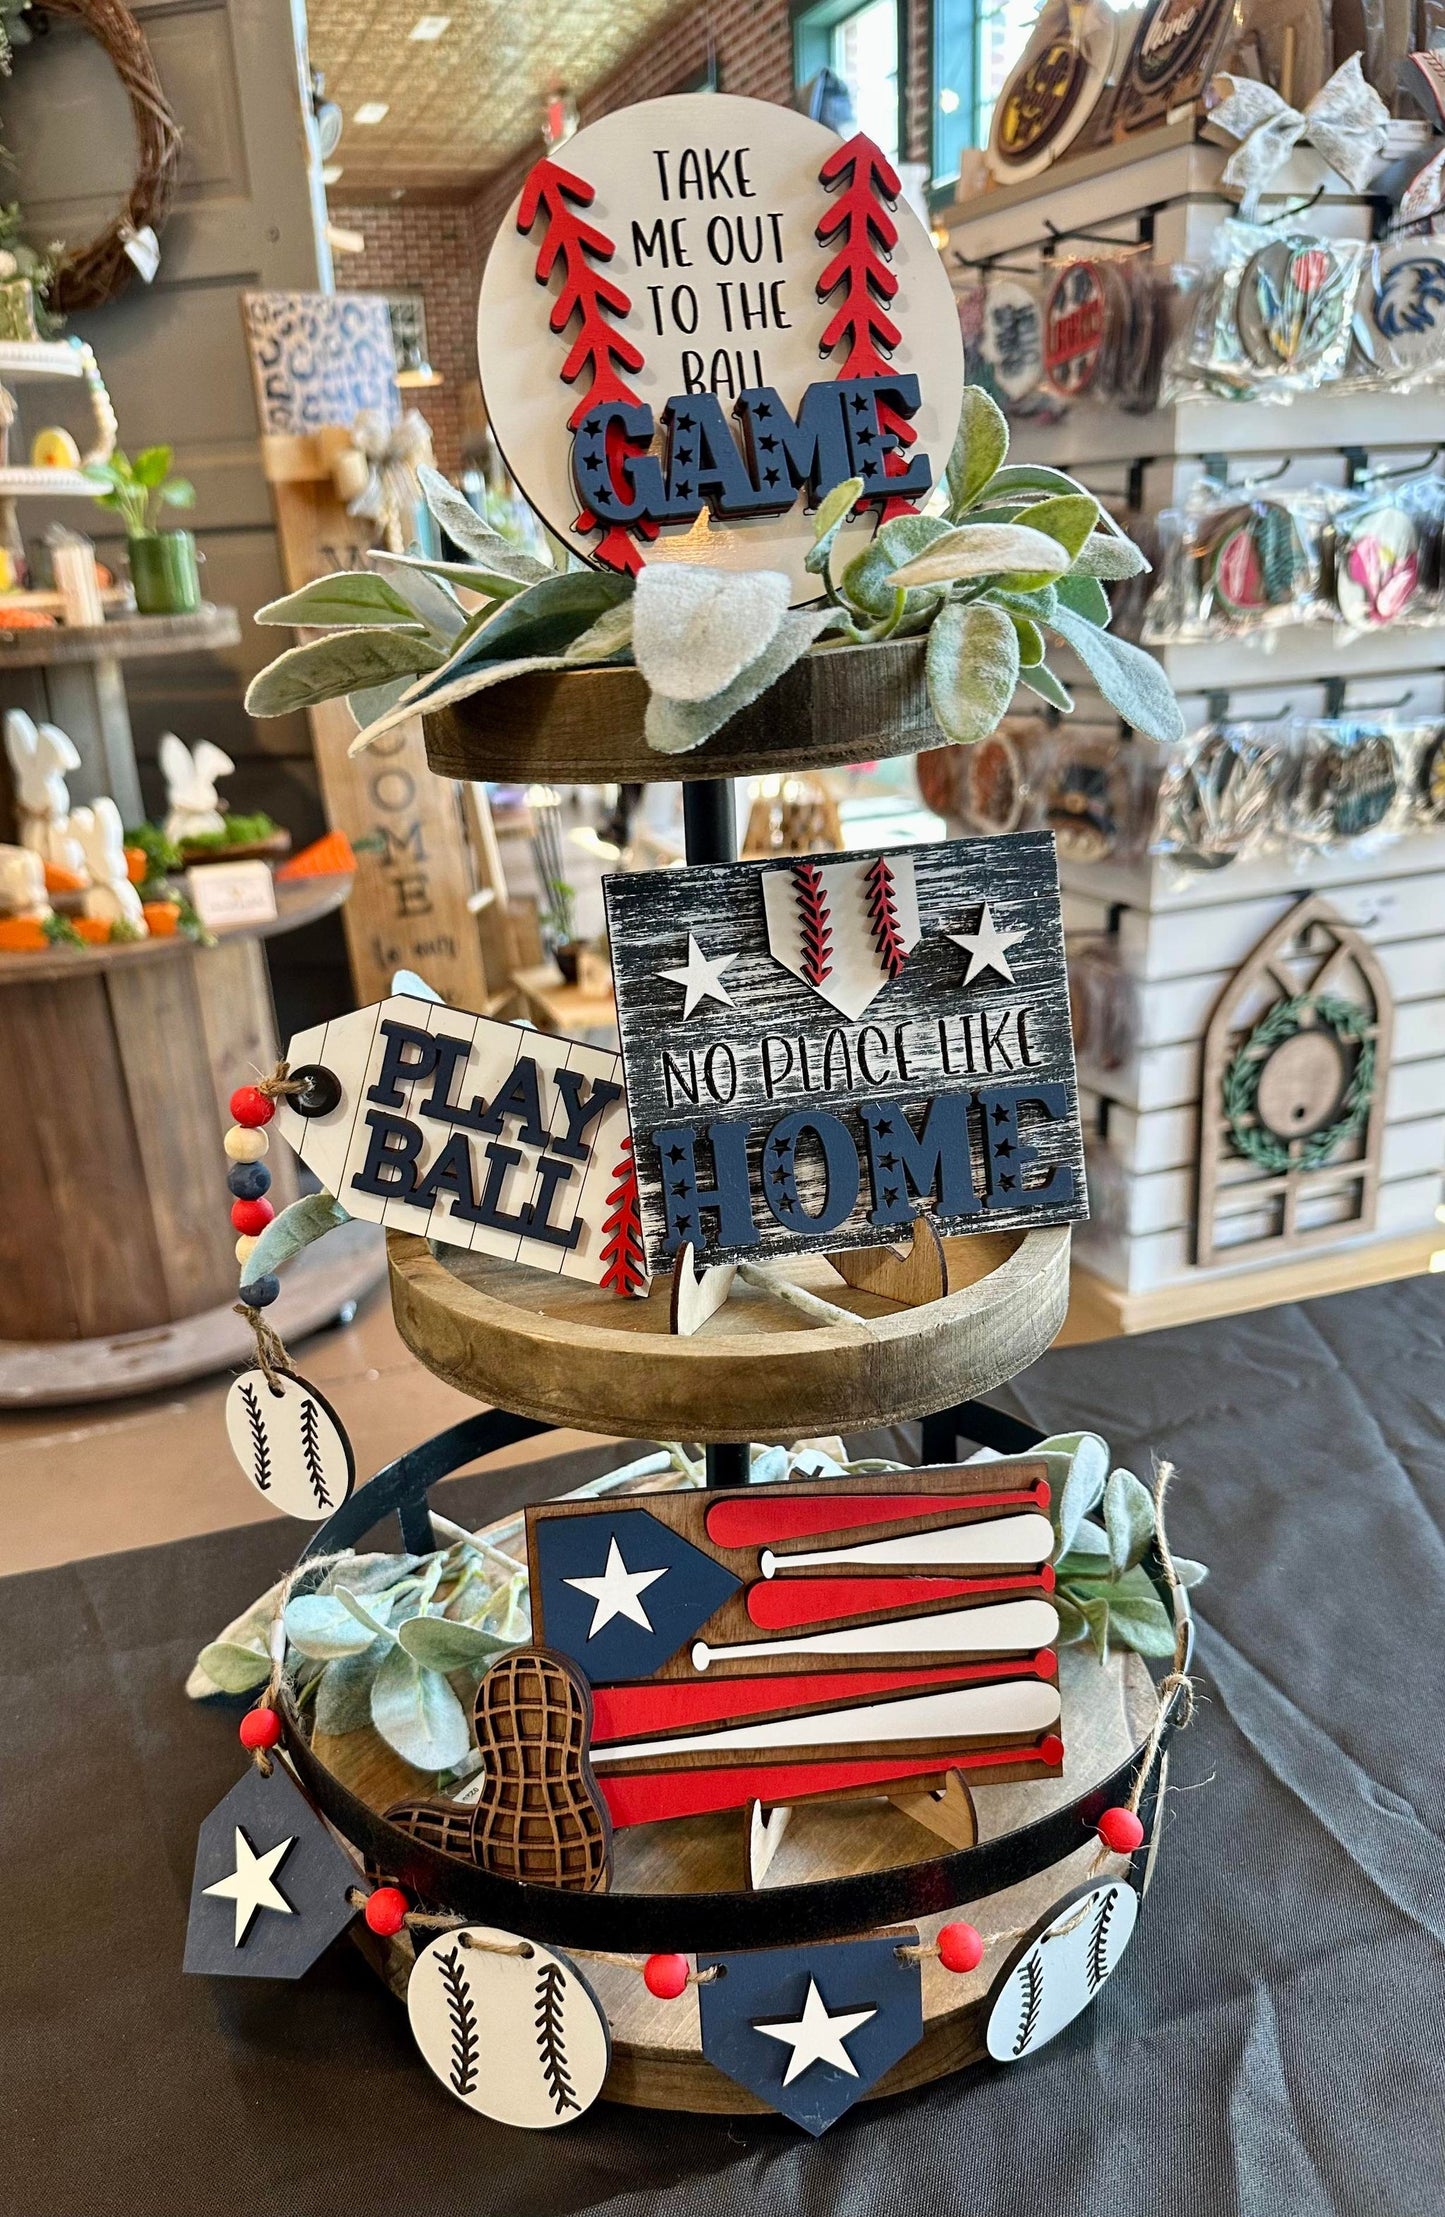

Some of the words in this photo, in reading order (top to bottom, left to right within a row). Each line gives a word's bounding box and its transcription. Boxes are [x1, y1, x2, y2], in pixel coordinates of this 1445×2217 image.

[652, 147, 758, 201] TAKE
[631, 217, 692, 269] ME
[706, 212, 785, 265] OUT
[646, 284, 699, 336] TO
[716, 279, 793, 334] THE
[573, 373, 933, 522] GAME
[367, 1019, 622, 1162] PLAY
[661, 1042, 738, 1109] NO
[760, 1021, 920, 1099] PLACE
[937, 1006, 1043, 1075] LIKE
[351, 1109, 584, 1250] BALL
[652, 1082, 1075, 1253] HOME
